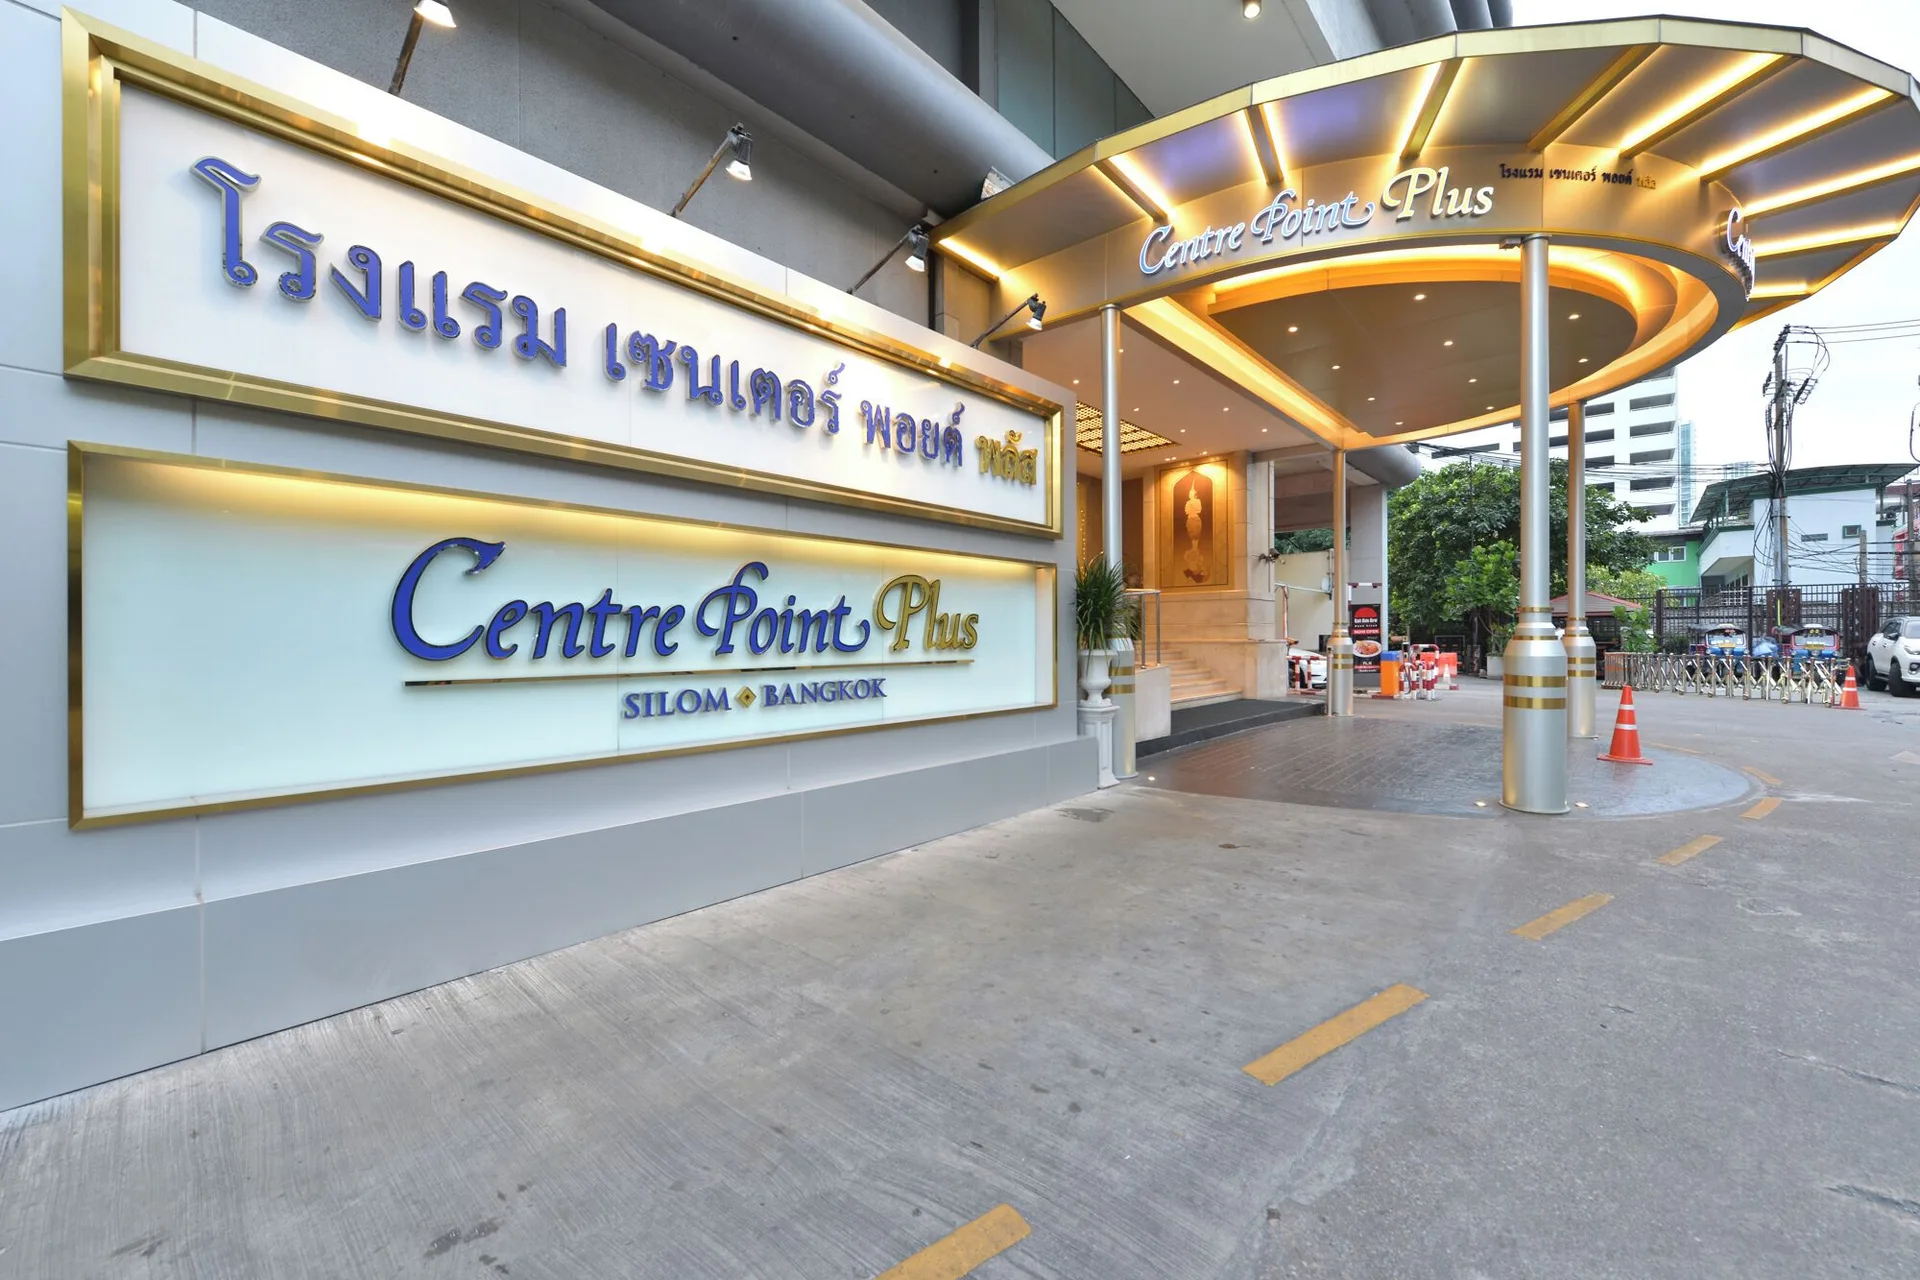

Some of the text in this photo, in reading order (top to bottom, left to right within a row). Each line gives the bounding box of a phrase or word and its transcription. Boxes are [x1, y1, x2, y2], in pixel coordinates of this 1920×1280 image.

[1138, 166, 1495, 275] Centre Point Plus
[1499, 163, 1543, 179] โรงแรม
[188, 155, 1039, 486] โรงแรม เซนเตอร์ พอยต์ พลัส
[391, 537, 980, 662] Centre Point Plus
[622, 678, 888, 720] SILOM BANGKOK
